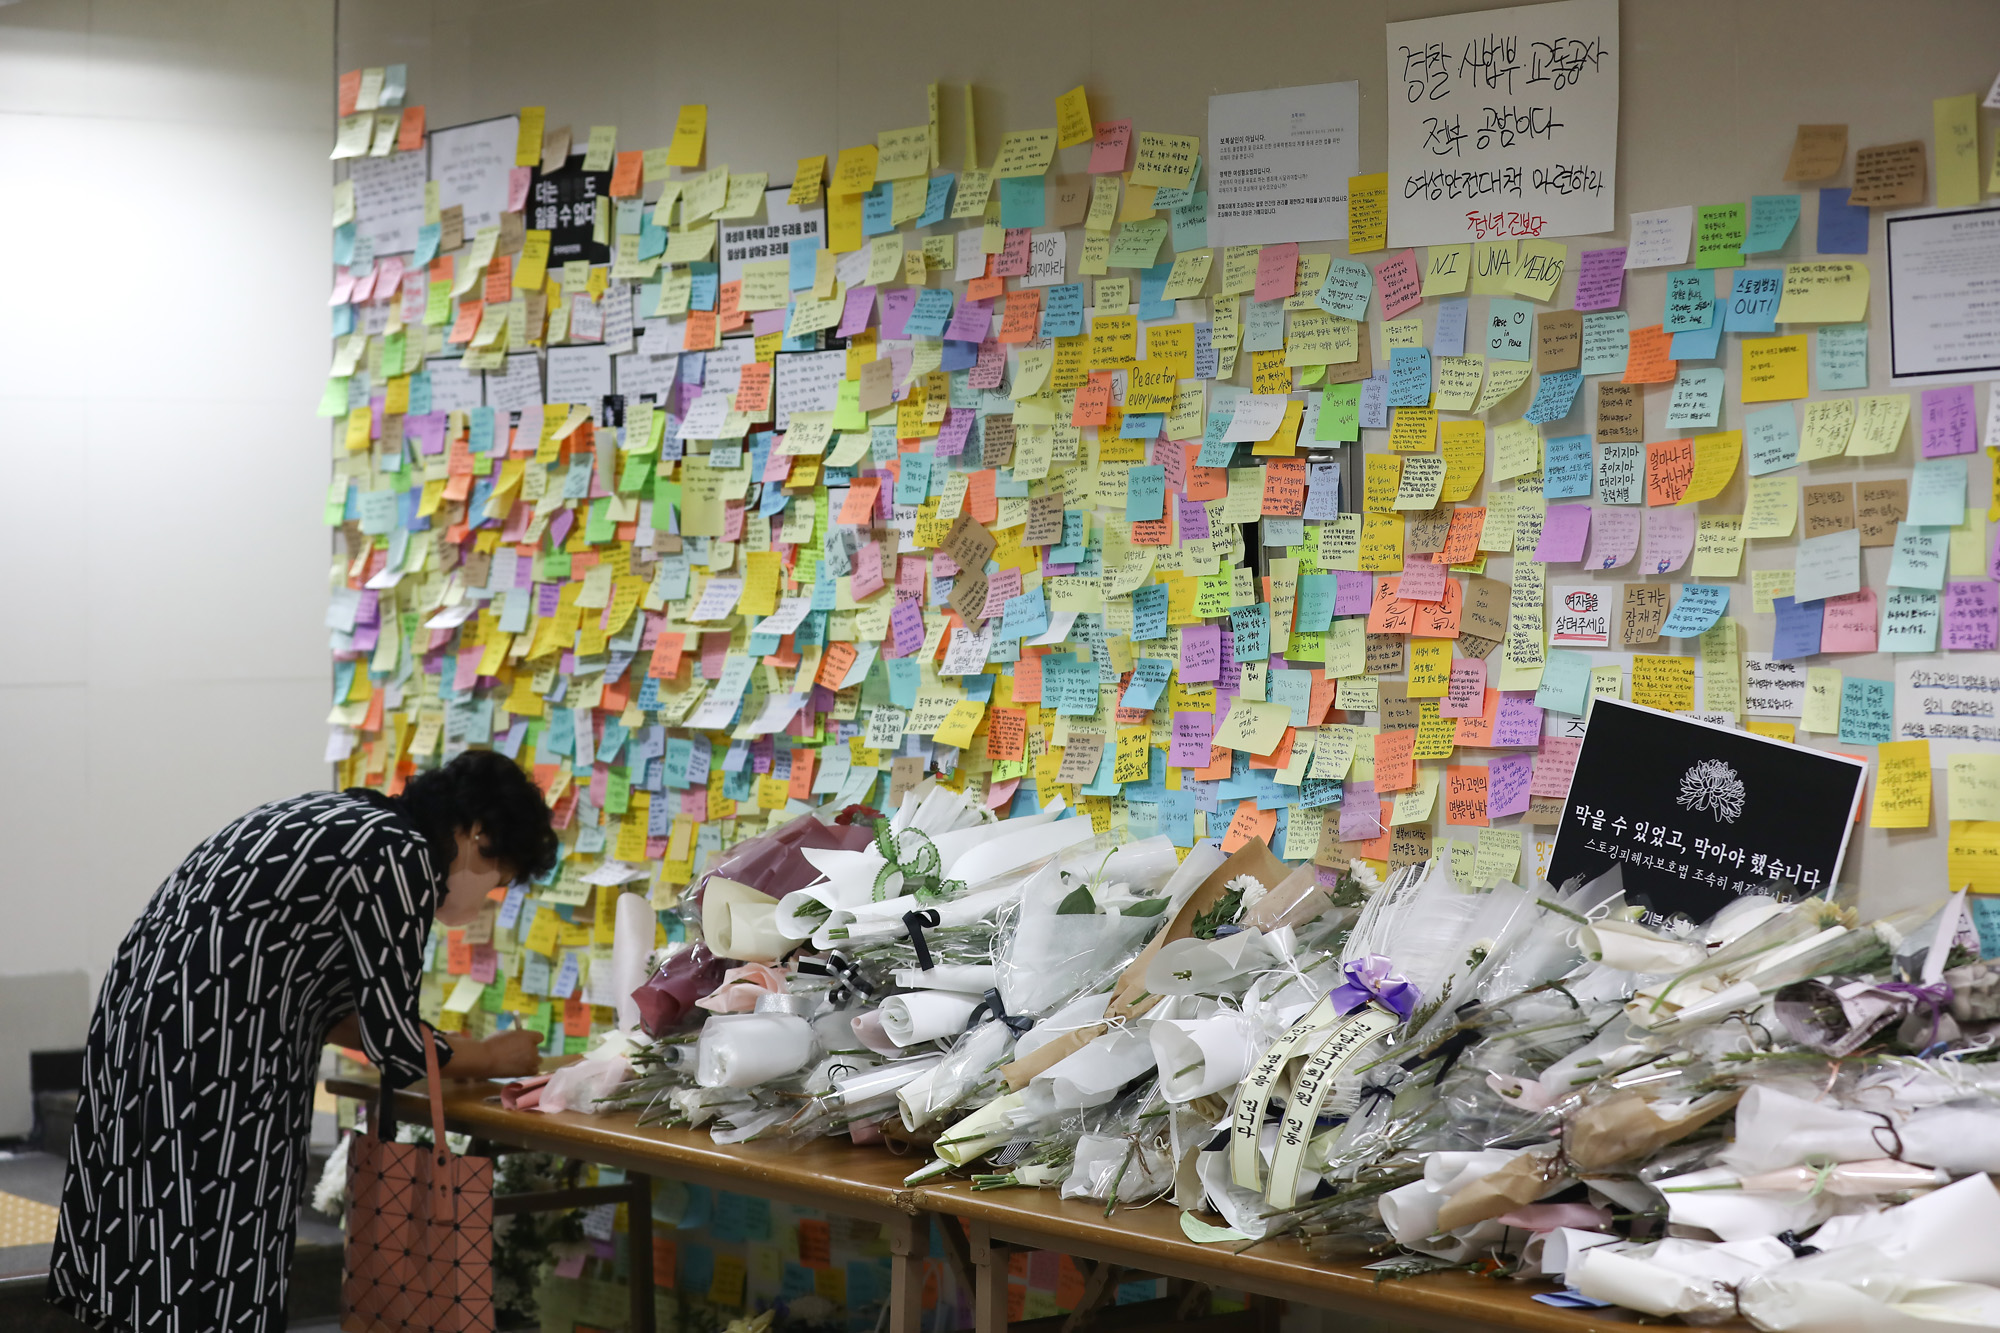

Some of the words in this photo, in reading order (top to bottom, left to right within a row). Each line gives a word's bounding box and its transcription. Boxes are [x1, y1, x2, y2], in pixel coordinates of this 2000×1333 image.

[1423, 114, 1468, 157] 전부
[1431, 252, 1459, 276] NI
[1478, 247, 1511, 277] UNA
[1514, 254, 1565, 287] MENOS
[1736, 278, 1779, 295] 스토킹범죄
[1735, 298, 1773, 316] OUT!
[1132, 366, 1163, 389] Peace
[1163, 367, 1177, 385] for
[1604, 445, 1640, 461] 만지지마
[1650, 446, 1681, 471] 얼마나
[1682, 443, 1692, 462] 더
[1600, 459, 1634, 477] 죽이지마
[1600, 473, 1635, 487] 때리지마
[1601, 486, 1630, 503] 강력처벌
[1665, 483, 1682, 501] 하는
[1564, 593, 1598, 612] 여자들을
[1626, 588, 1665, 608] 스토커는
[1555, 616, 1607, 635] 살려주세요
[1625, 607, 1661, 627] 잠재적
[1624, 624, 1657, 643] 살인마
[1451, 777, 1466, 793] 삼가
[1466, 776, 1488, 793] 고인의
[1575, 804, 1607, 831] 막을
[1610, 815, 1628, 837] 수
[1634, 820, 1688, 855] 있었고,
[1693, 837, 1746, 869] 막아야
[1750, 852, 1821, 890] 했습니다
[1584, 838, 1689, 880] 스토킹피해자보호법
[1691, 867, 1728, 891] 조속히
[1252, 1053, 1283, 1088] 명복을
[1237, 1099, 1259, 1139] 빕니다
[1282, 1118, 1304, 1146] 일동
